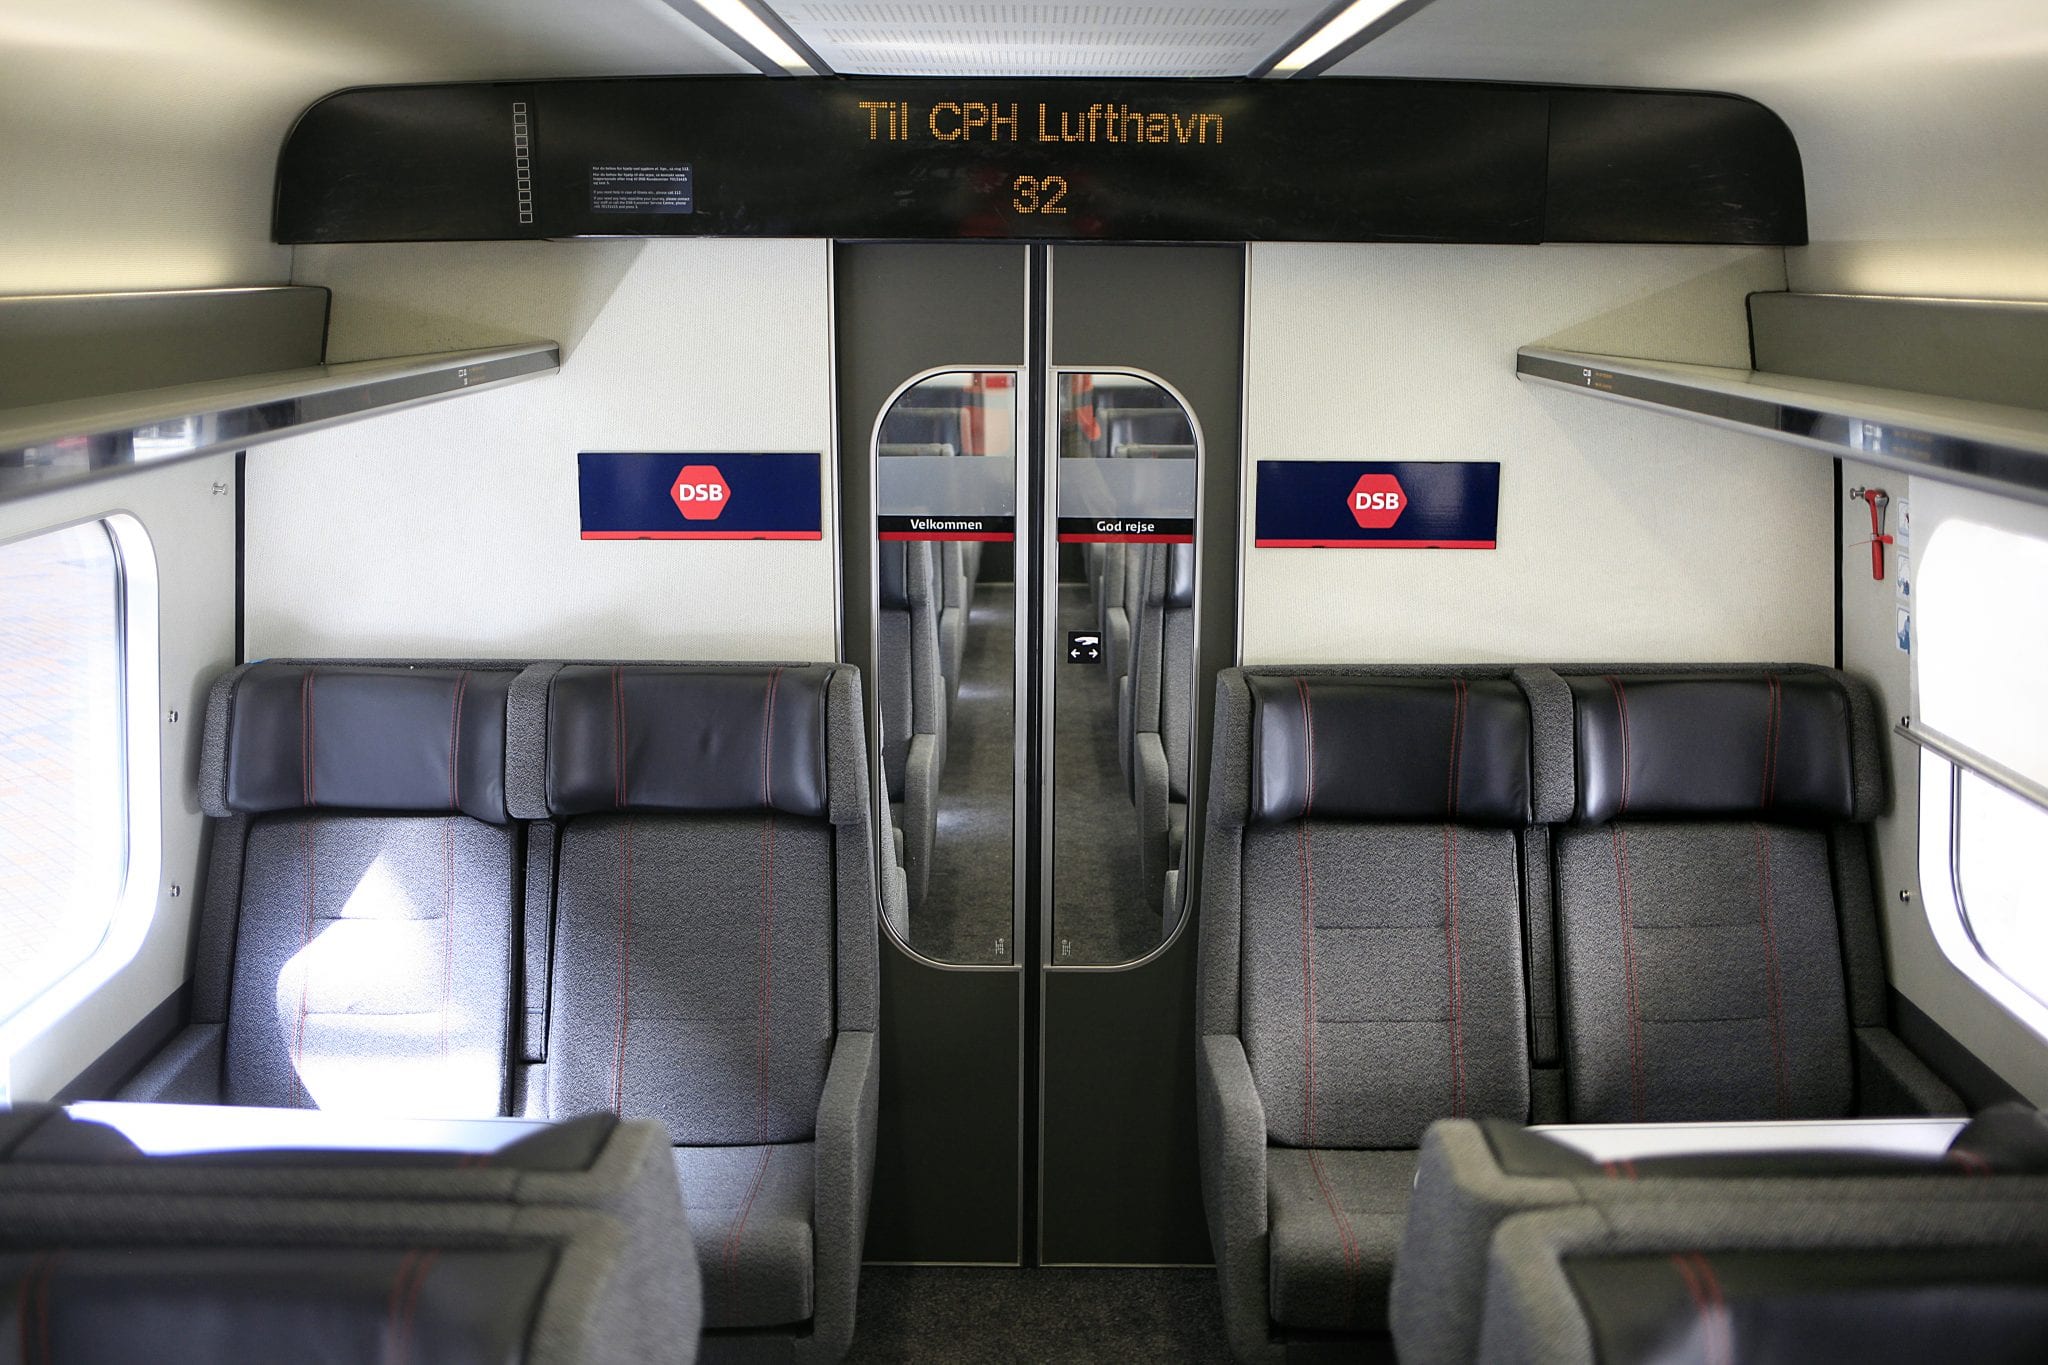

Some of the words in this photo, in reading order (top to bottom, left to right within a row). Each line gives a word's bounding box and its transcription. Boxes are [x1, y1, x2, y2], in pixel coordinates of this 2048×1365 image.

[859, 101, 908, 140] Til
[929, 102, 1018, 141] CPH
[1039, 103, 1223, 144] Lufthavn
[1013, 175, 1067, 214] 32
[679, 483, 723, 502] DSB
[1355, 492, 1399, 510] DSB
[910, 518, 983, 531] Velkommen
[1096, 520, 1123, 532] God
[1125, 520, 1155, 535] rejse
